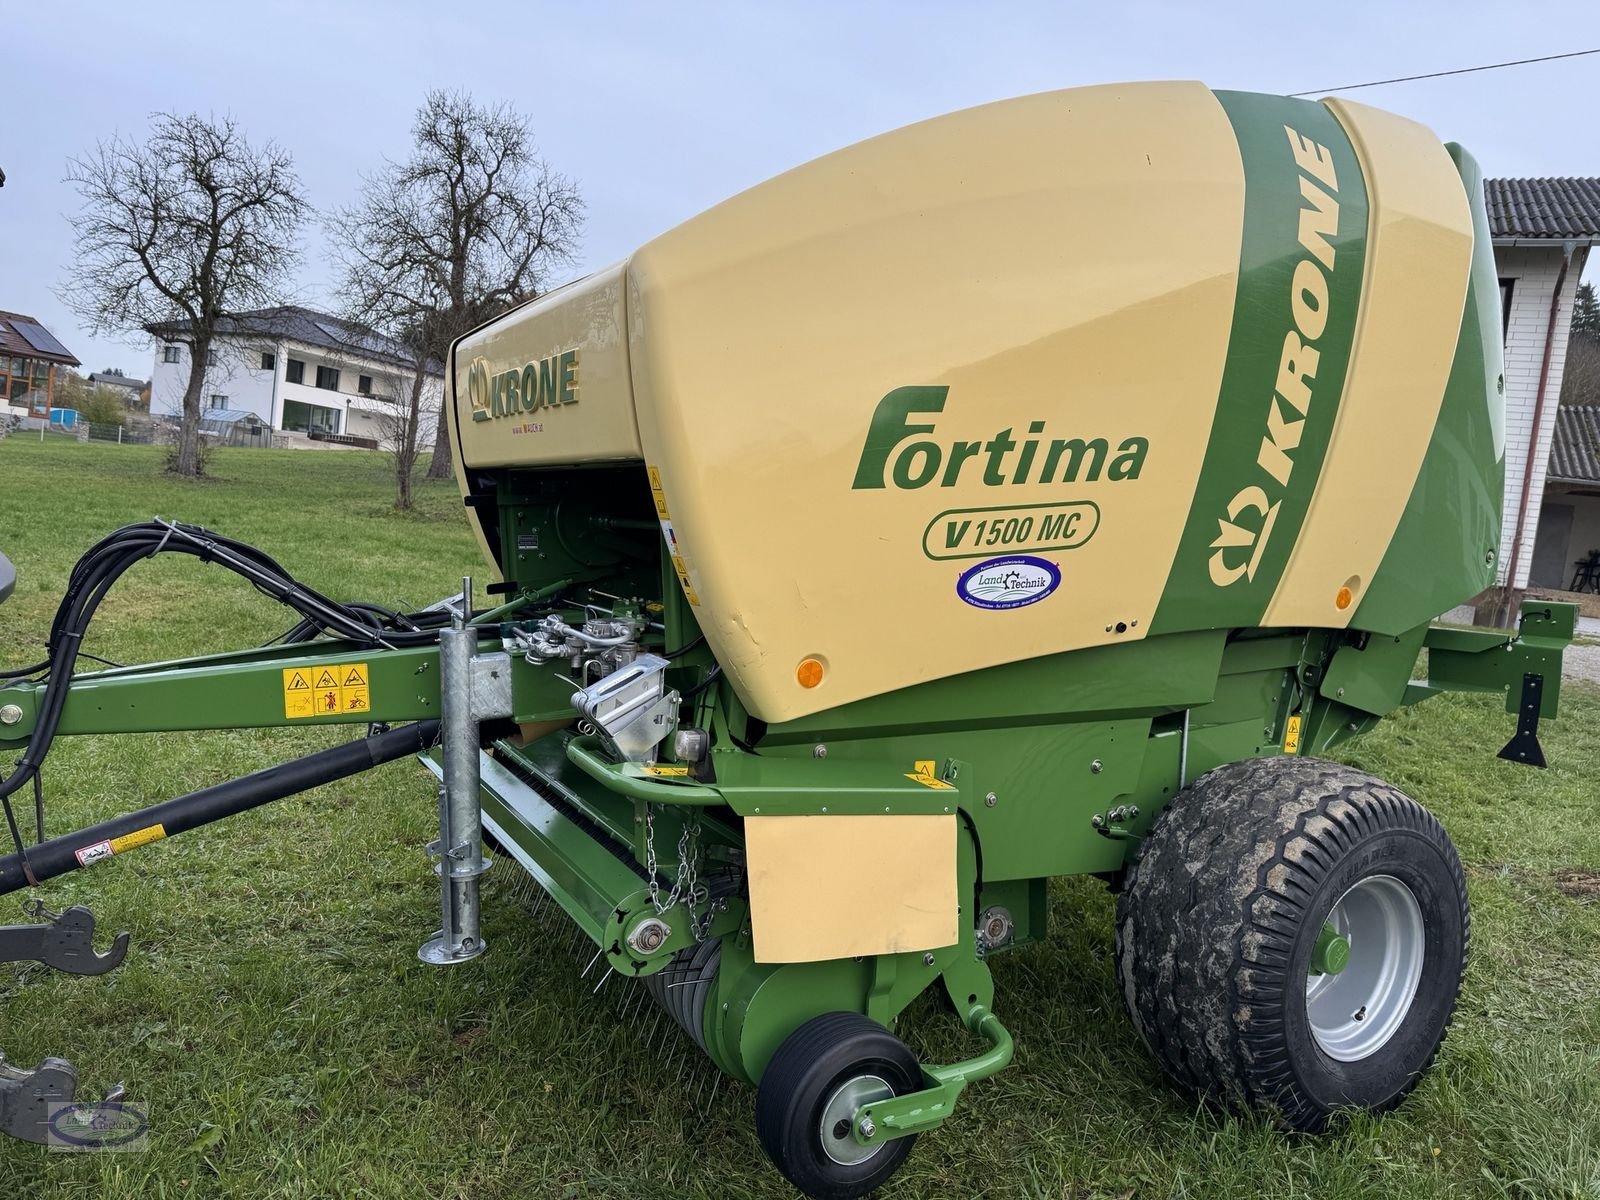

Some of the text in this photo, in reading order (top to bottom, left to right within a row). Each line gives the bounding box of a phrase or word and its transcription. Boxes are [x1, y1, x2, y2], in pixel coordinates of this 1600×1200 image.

[1257, 124, 1340, 487] KRONE
[491, 347, 579, 419] KRONE
[851, 385, 1150, 490] Fortima
[945, 511, 1082, 549] V 1500 MC
[978, 573, 1004, 586] Land
[1010, 576, 1046, 590] Technik
